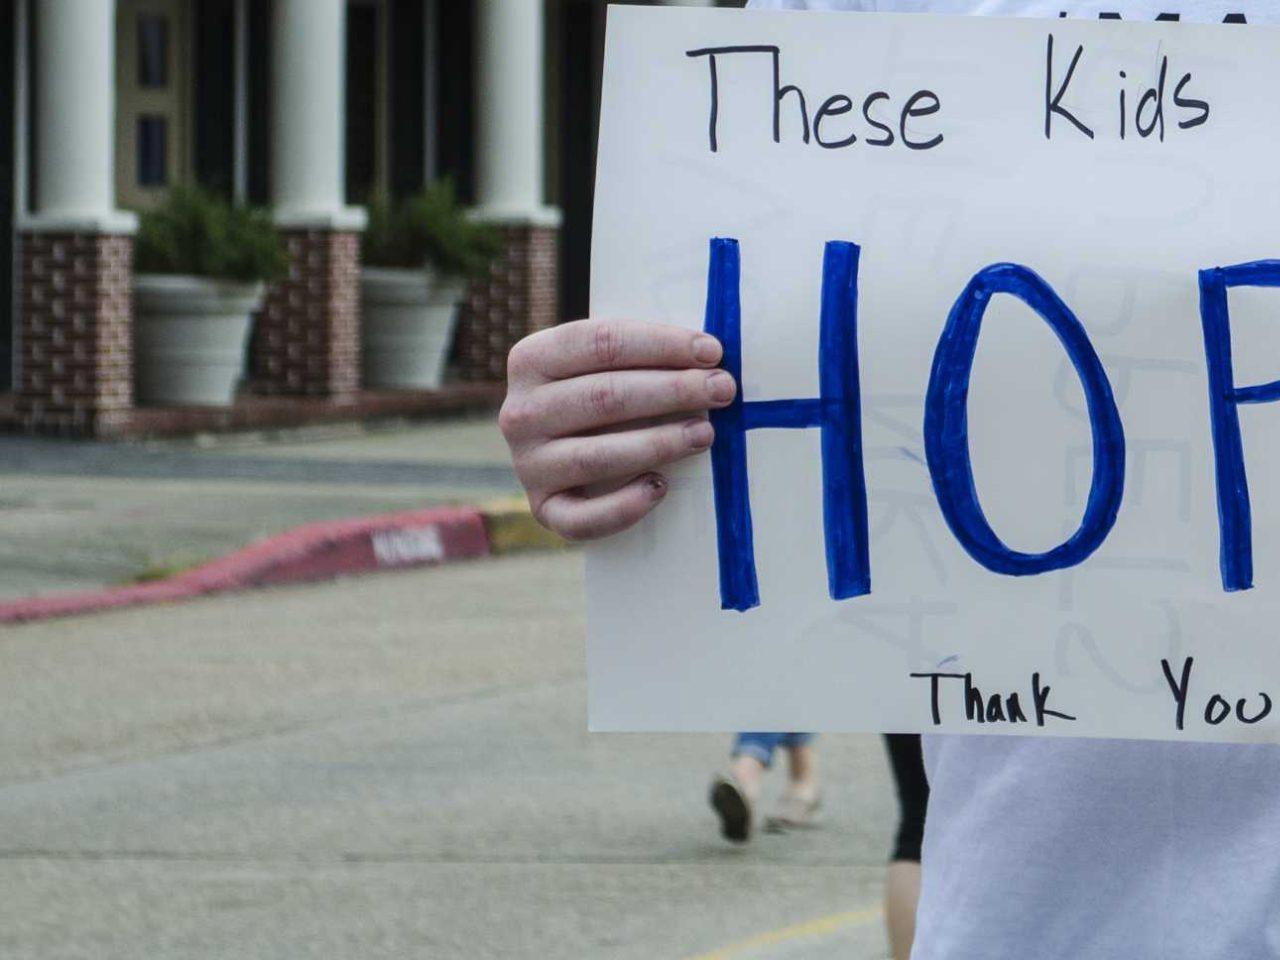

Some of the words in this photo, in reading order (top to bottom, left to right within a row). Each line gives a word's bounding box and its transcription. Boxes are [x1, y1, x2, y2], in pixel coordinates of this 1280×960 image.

[685, 45, 944, 152] These
[1045, 33, 1210, 142] Kids
[909, 672, 1077, 727] Thank
